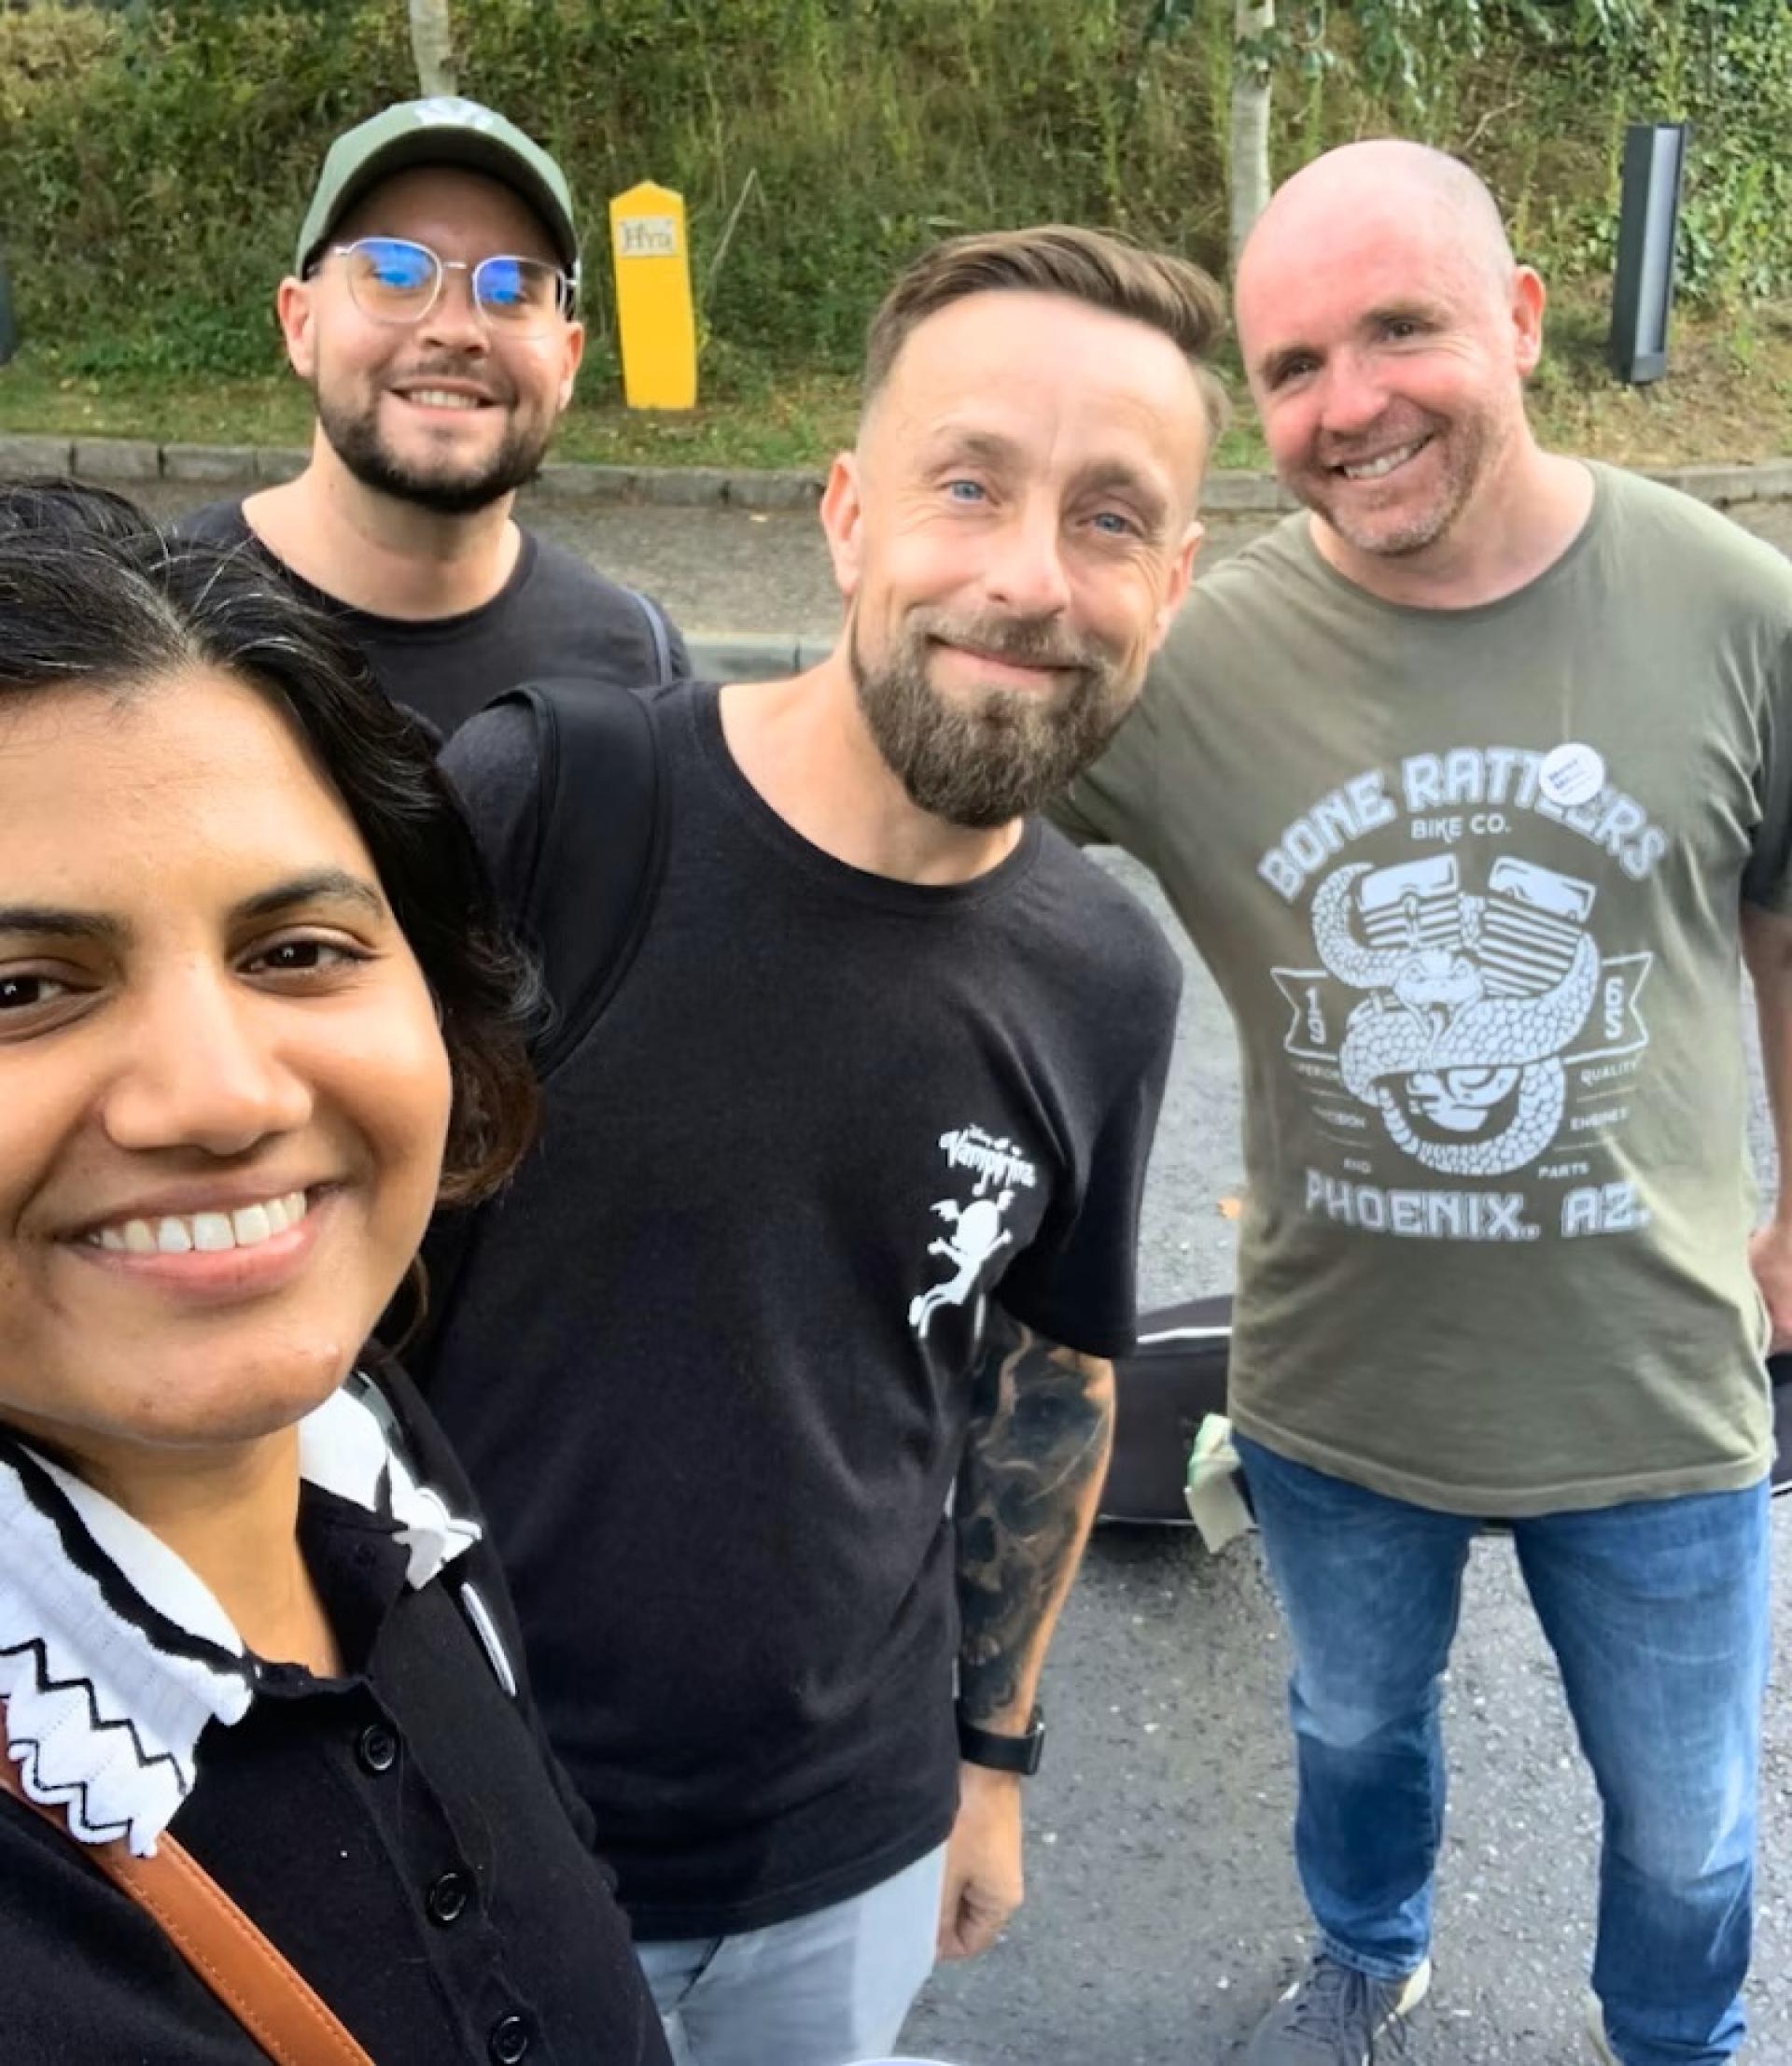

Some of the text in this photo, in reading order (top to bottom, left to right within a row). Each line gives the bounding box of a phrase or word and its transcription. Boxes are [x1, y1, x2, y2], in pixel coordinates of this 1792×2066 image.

[1258, 769, 1397, 906] BONE
[1410, 812, 1512, 842] BIKE CO.
[1537, 1161, 1589, 1179] PARTS
